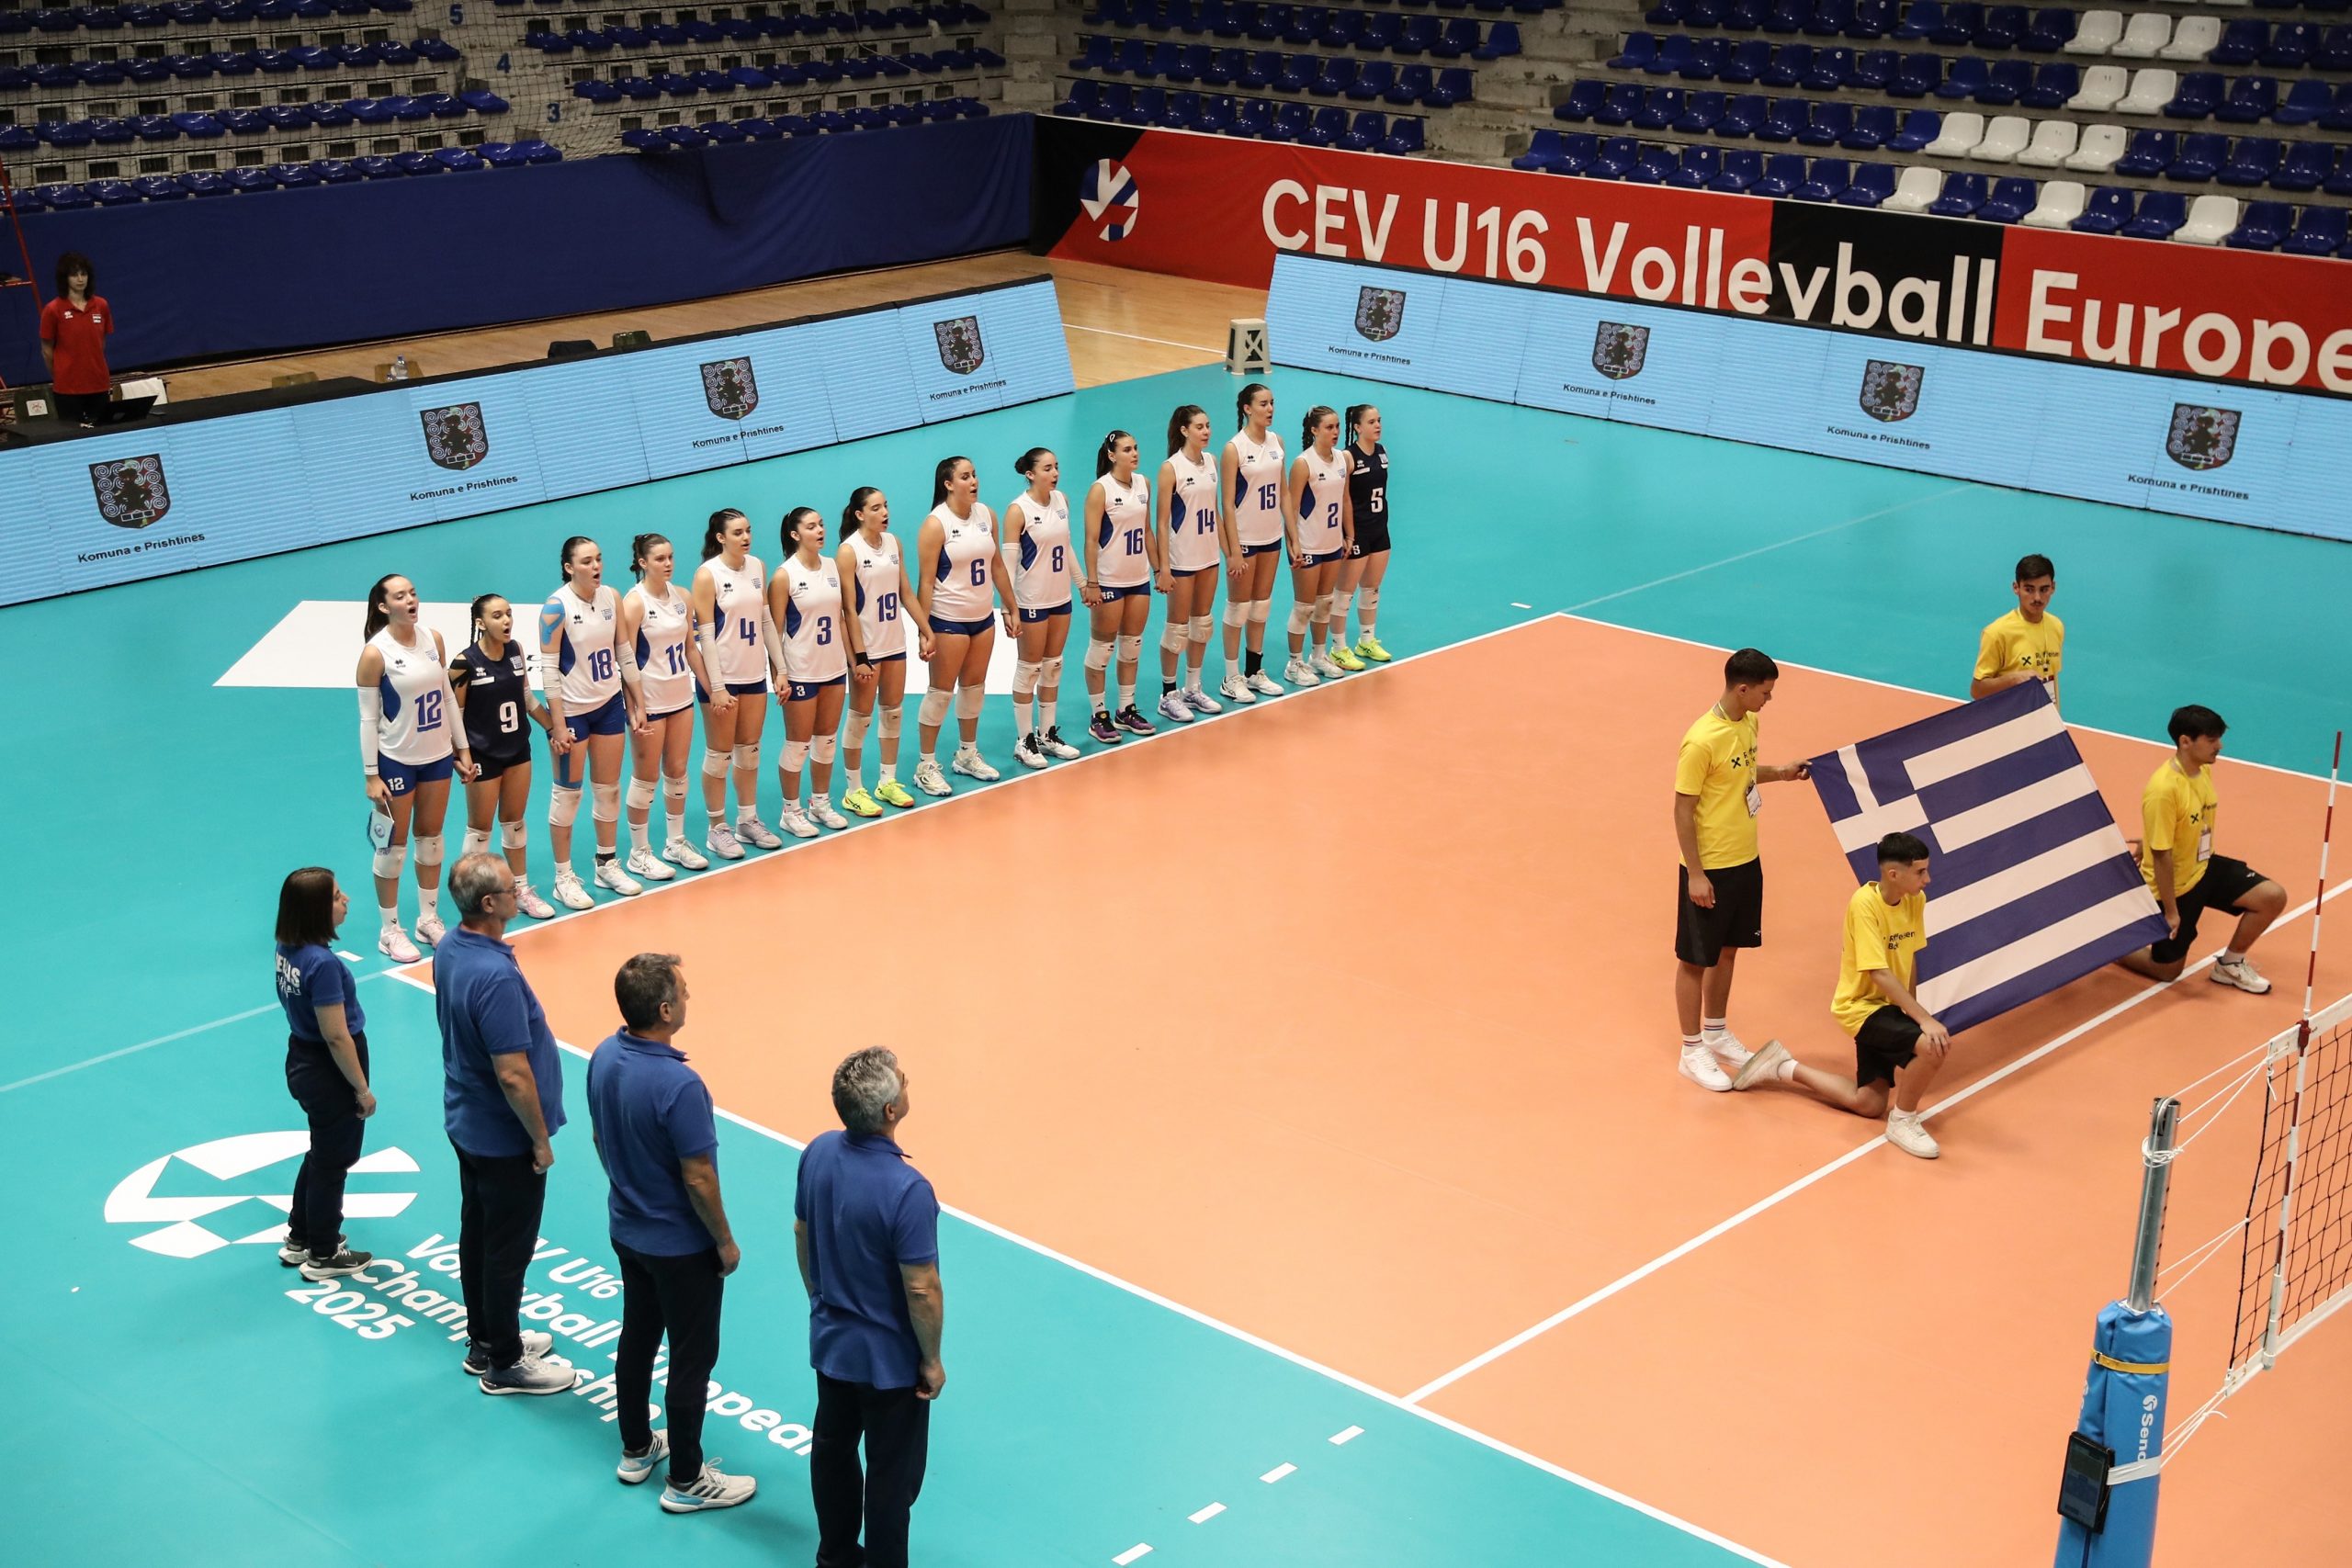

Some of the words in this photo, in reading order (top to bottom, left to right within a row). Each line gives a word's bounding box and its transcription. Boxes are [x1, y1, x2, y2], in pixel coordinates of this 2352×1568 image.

[449, 4, 464, 26] 5
[496, 52, 512, 73] 4
[548, 102, 560, 123] 3
[1261, 178, 1400, 262] CEV
[1422, 197, 1549, 284] U16
[1576, 217, 1996, 346] Volleyball
[2026, 269, 2352, 393] Europe
[1329, 345, 1362, 357] Komuna
[929, 389, 962, 401] Komuna
[1563, 383, 1600, 396] Komuna
[692, 435, 731, 448] Komuna
[1826, 425, 1869, 439] Komuna
[410, 487, 456, 501] Komuna
[467, 476, 518, 491] Prishtines
[2127, 474, 2177, 489] Komuna
[1258, 483, 1276, 511] 15
[1371, 488, 1384, 513] 5
[1196, 508, 1215, 536] 14
[1327, 502, 1339, 529] 2
[77, 547, 131, 563] Komuna
[133, 545, 141, 553] e
[144, 533, 206, 551] Prishtines
[1123, 527, 1144, 556] 16
[970, 558, 986, 587] 6
[1052, 545, 1064, 573] 8
[876, 592, 898, 623] 19
[740, 617, 757, 647] 4
[817, 615, 831, 646] 3
[587, 648, 614, 682] 18
[665, 642, 686, 675] 11
[796, 685, 806, 697] 3
[414, 690, 442, 726] 12
[499, 701, 519, 733] 9
[387, 777, 405, 792] 12
[548, 1258, 624, 1300] U16
[284, 1280, 416, 1340] 2025
